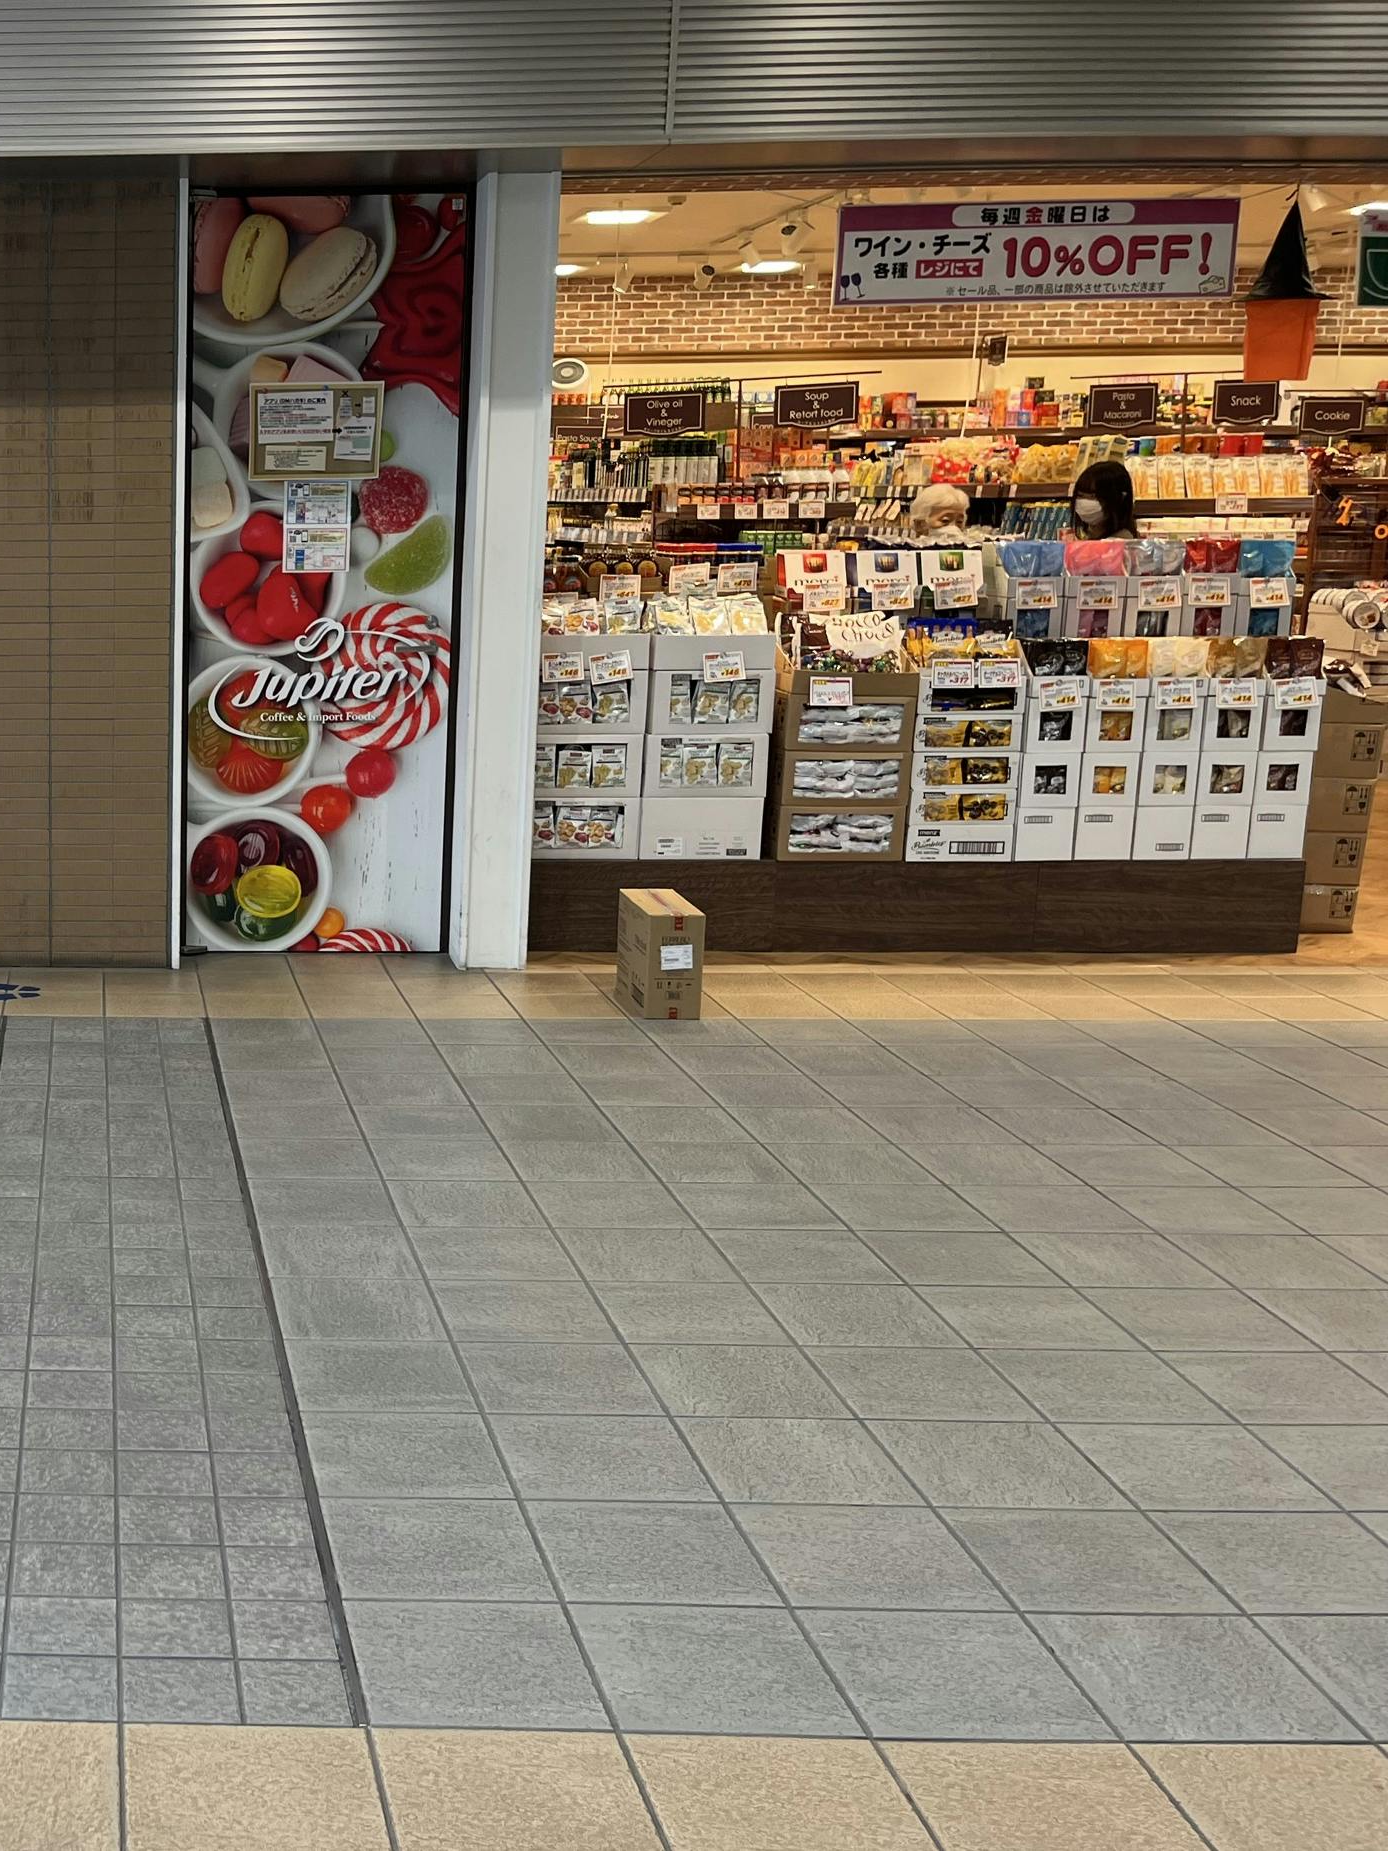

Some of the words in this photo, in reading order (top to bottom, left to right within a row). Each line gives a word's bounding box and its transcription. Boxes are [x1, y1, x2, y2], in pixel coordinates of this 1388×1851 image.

[981, 205, 1111, 226] 毎週金曜日は
[854, 231, 992, 258] ワイン・チーズ
[873, 261, 909, 280] 各種
[919, 261, 981, 277] レジにて
[804, 391, 829, 402] Soup
[1112, 391, 1135, 401] Pasta
[1230, 395, 1261, 407] Snack
[646, 400, 670, 409] Olive
[672, 399, 683, 408] oil
[812, 400, 820, 409] &
[1119, 401, 1126, 410] &
[660, 408, 668, 417] &
[789, 409, 818, 419] Retort
[820, 407, 844, 418] food
[1103, 409, 1142, 420] Macaroni
[1314, 410, 1351, 421] Cookie
[231, 664, 409, 708] Jupiter
[260, 712, 294, 722] Coffee
[296, 712, 307, 722] &
[308, 712, 344, 724] Import
[345, 712, 376, 722] Foods
